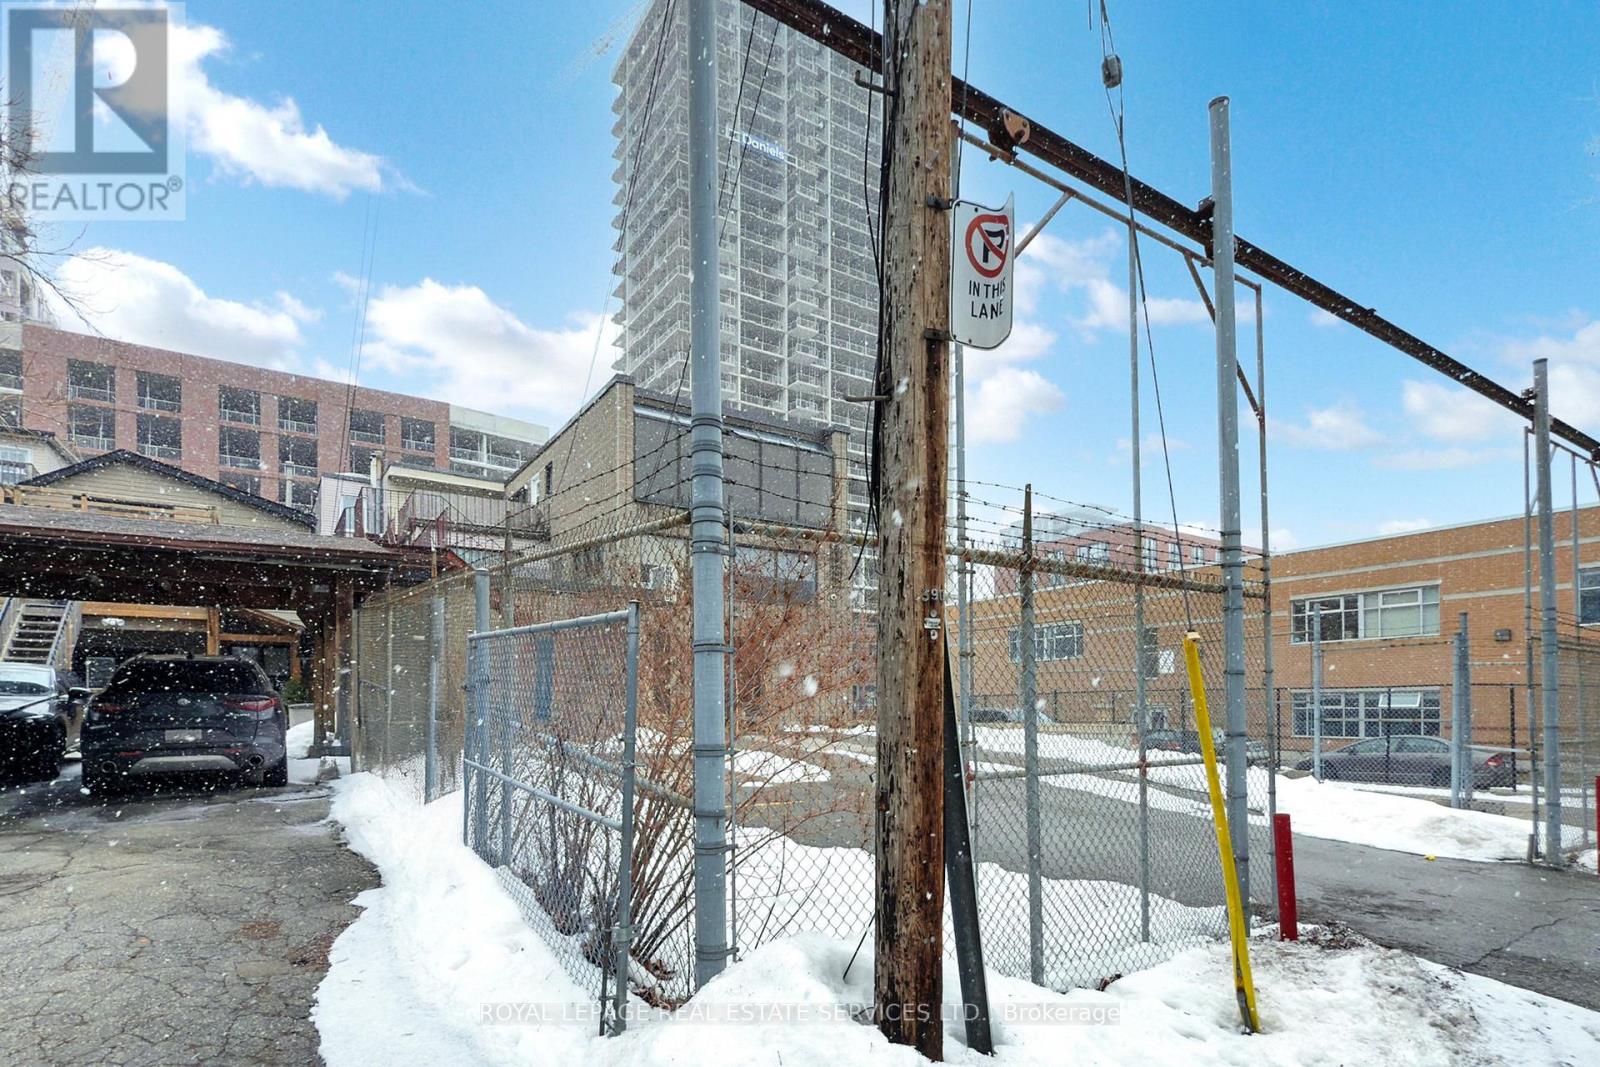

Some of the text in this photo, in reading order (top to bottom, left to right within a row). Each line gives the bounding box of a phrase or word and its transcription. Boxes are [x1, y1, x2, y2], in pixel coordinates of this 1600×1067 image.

[742, 132, 785, 160] Daniels
[969, 277, 1006, 299] IN THIS
[971, 299, 1004, 320] LANE
